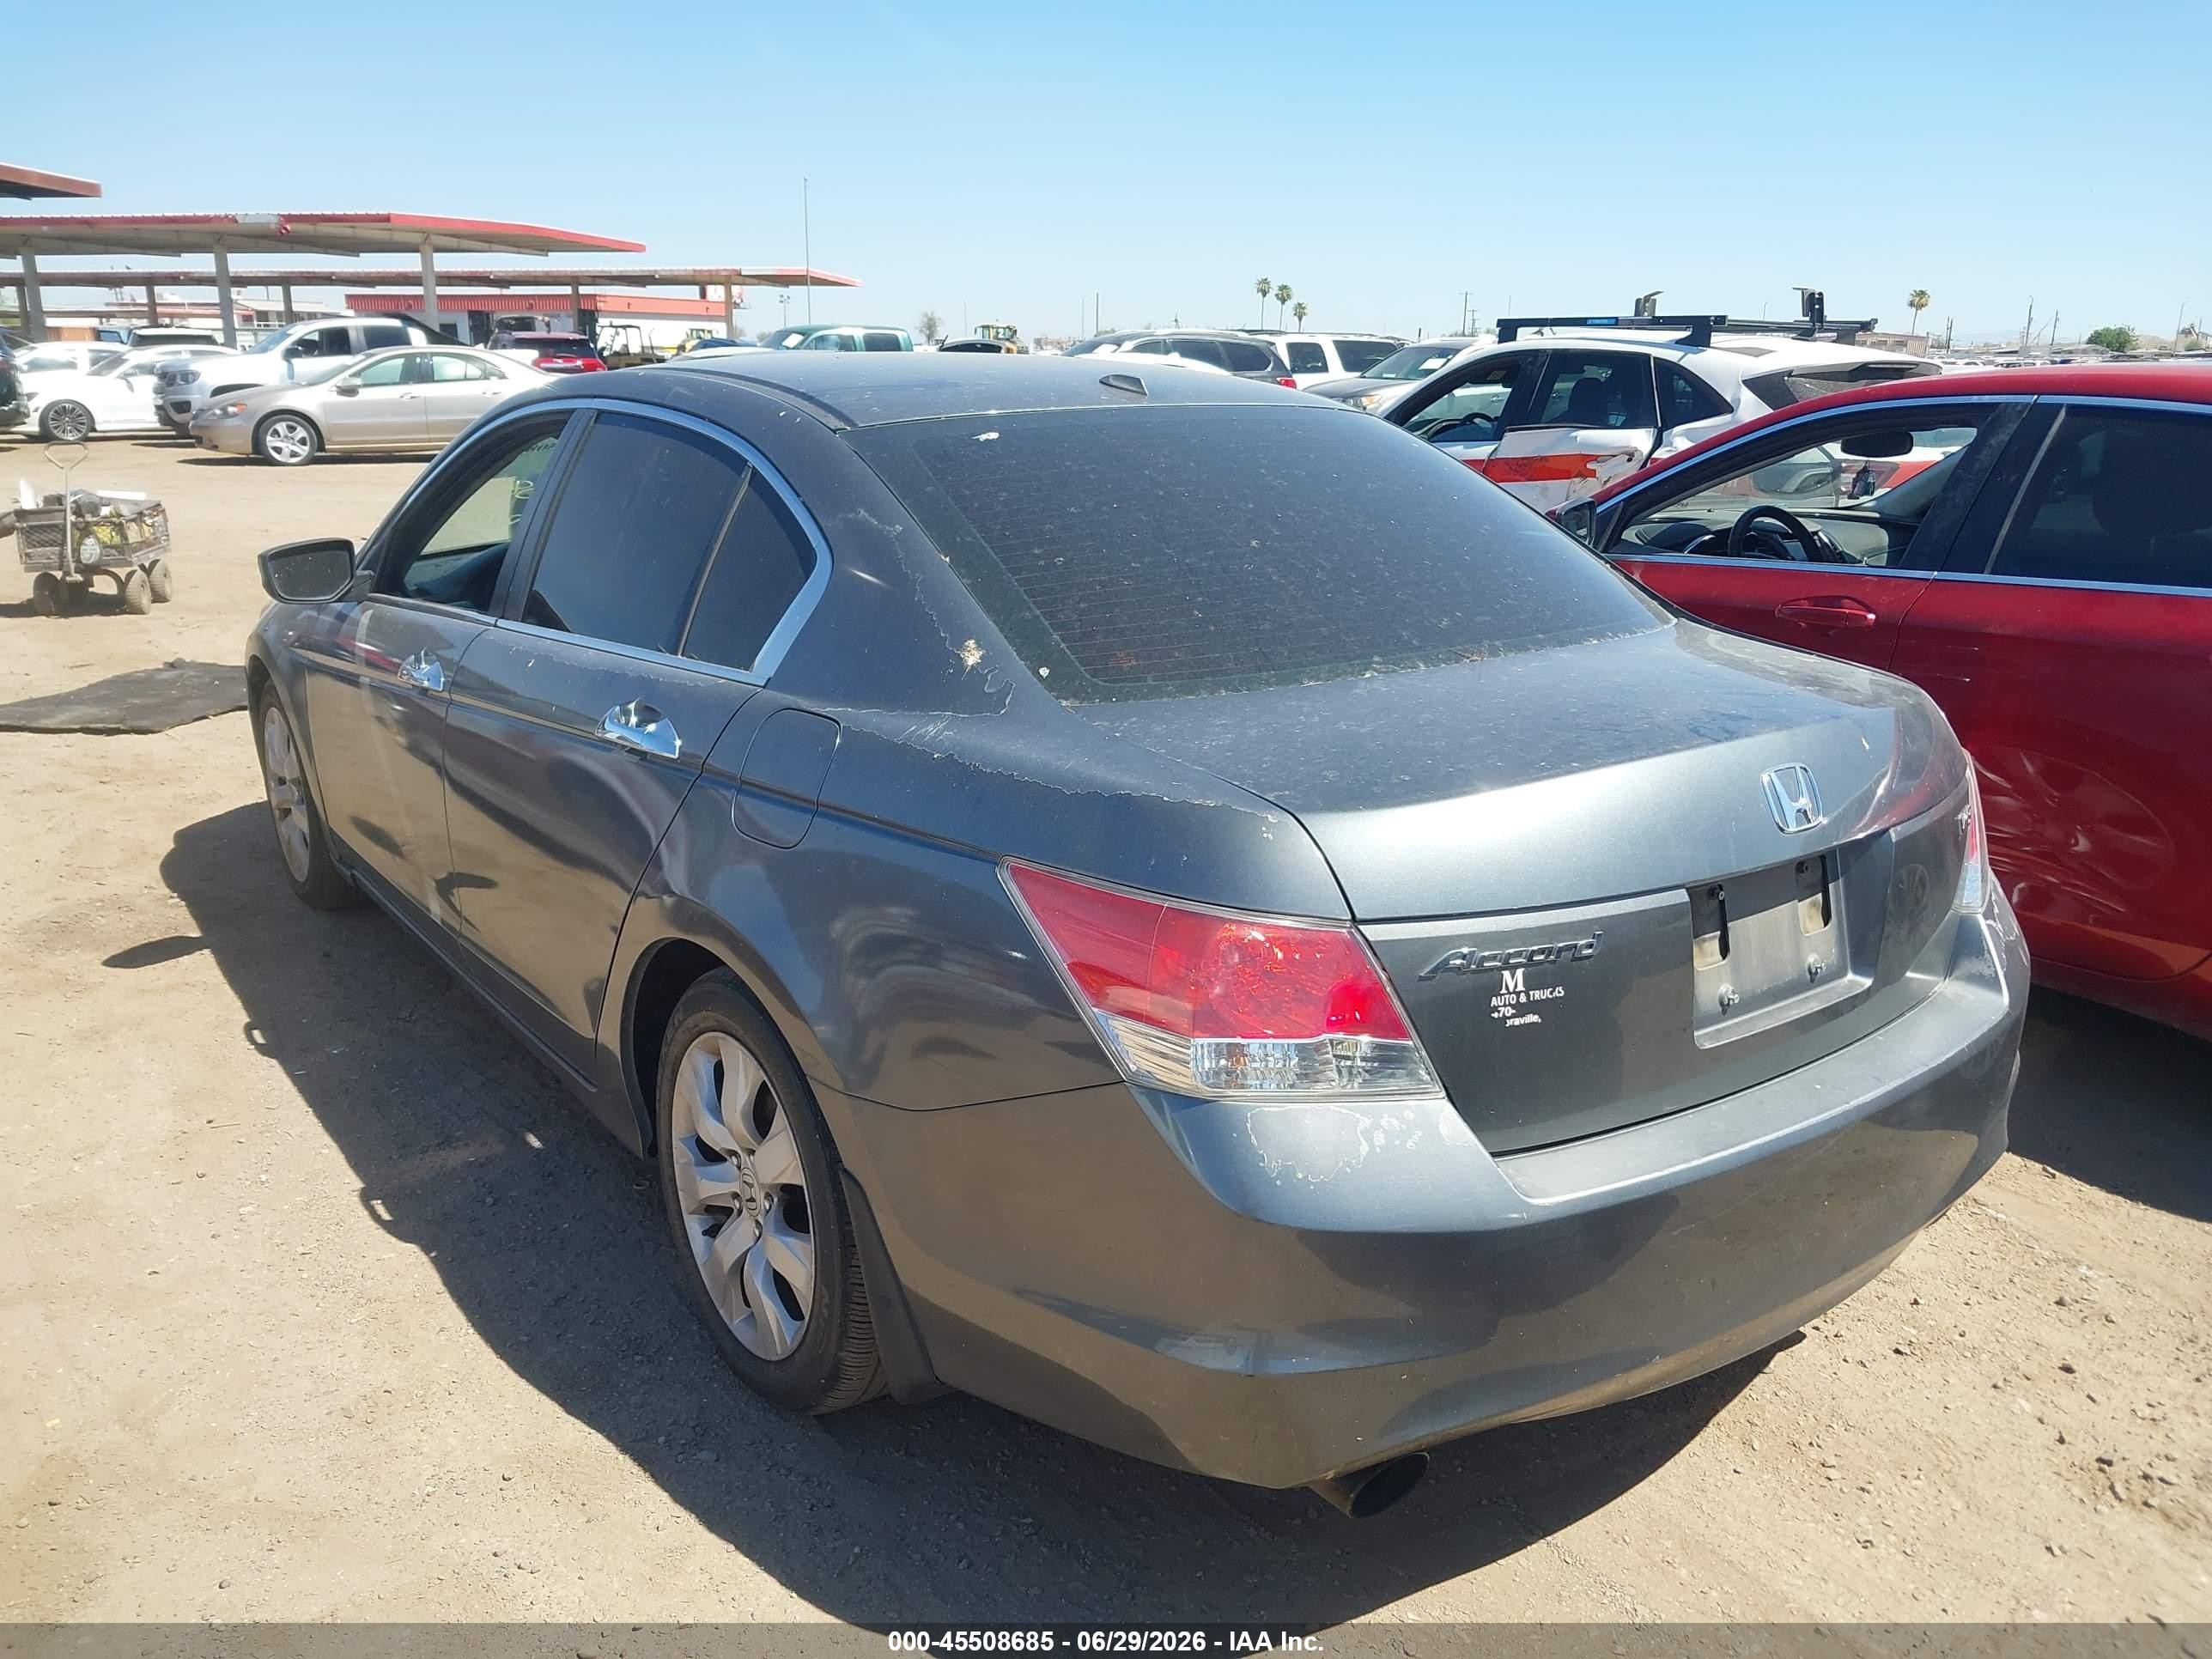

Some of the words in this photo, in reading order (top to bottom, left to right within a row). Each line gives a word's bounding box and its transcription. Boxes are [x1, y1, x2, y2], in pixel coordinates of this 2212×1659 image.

[1418, 931, 1604, 981] Accord
[1499, 968, 1526, 994] M
[1490, 994, 1517, 1007] AUTO
[1518, 992, 1527, 1003] &
